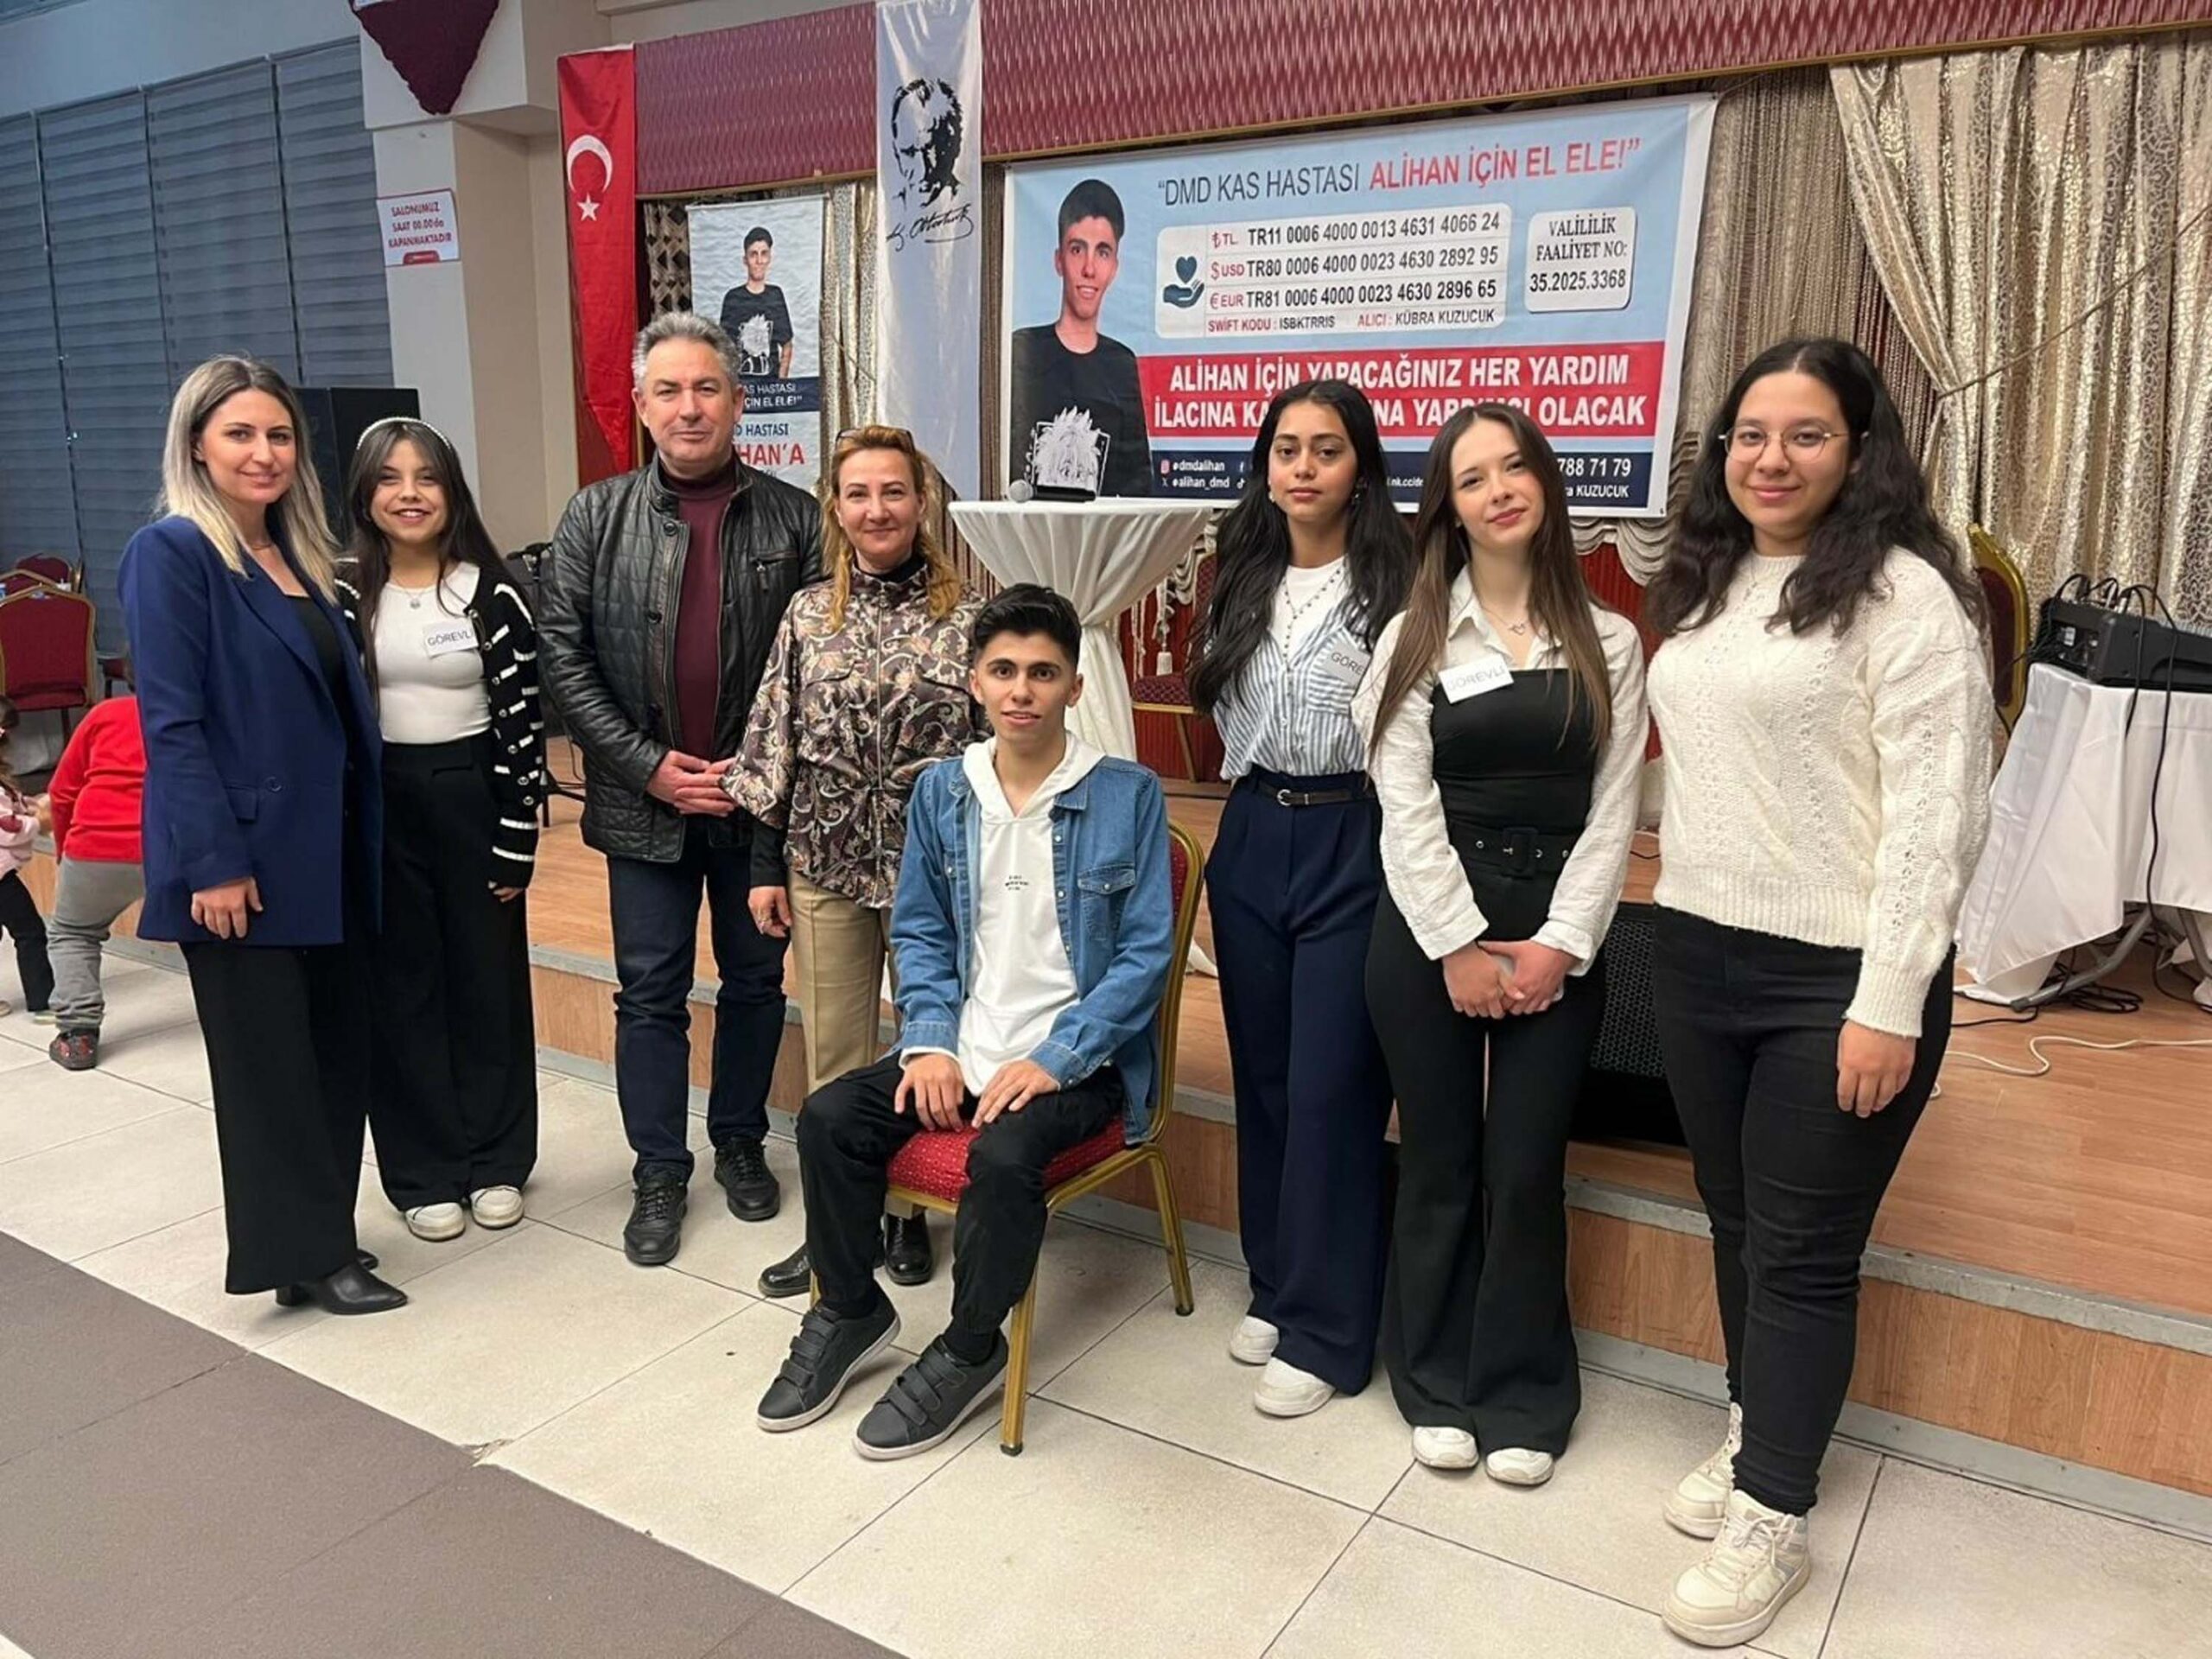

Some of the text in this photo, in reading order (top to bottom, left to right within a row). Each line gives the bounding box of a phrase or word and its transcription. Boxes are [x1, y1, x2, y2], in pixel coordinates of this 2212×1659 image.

[1217, 171, 1260, 201] KAS
[1267, 162, 1360, 198] HASTASI
[1370, 152, 1459, 191] ALİHAN
[1468, 143, 1517, 188] İÇİN
[1526, 145, 1557, 177] EL
[1248, 226, 1281, 246] TR11
[1287, 225, 1319, 244] 0006
[1323, 221, 1357, 240] 4000
[1361, 219, 1396, 239] 0013
[1401, 217, 1434, 236] 4631
[1440, 213, 1477, 233] 4066
[1481, 212, 1500, 231] 24
[1549, 213, 1616, 236] VALİLİLİK
[1247, 259, 1281, 277] TR80
[1286, 257, 1319, 276] 0006
[1323, 254, 1357, 273] 4000
[1360, 252, 1395, 270] 0023
[1399, 250, 1434, 269] 4630
[1440, 247, 1476, 267] 2892
[1480, 245, 1499, 264] 95
[1536, 238, 1627, 261] FAALİYET NO:
[1529, 269, 1626, 292] 35.2025.3368
[1246, 290, 1280, 308] TR81
[1285, 289, 1318, 307] 0006
[1321, 286, 1354, 305] 4000
[1358, 284, 1393, 303] 0023
[1397, 283, 1432, 301] 4630
[1437, 281, 1473, 300] 2896
[1478, 279, 1497, 298] 65
[1242, 318, 1271, 331] KODU
[1395, 309, 1434, 326] KÜBRA
[1438, 308, 1495, 325] KUZUCUK
[1170, 359, 1249, 391] ALİHAN
[1255, 356, 1300, 397] İÇİN
[1469, 357, 1521, 387] HER
[1529, 354, 1629, 387] YARDIM
[1154, 397, 1236, 428] İLACINA
[1538, 395, 1648, 427] OLACAK
[746, 423, 789, 436] HASTASI
[1556, 458, 1631, 477] 788 71 79
[1576, 485, 1630, 498] KUZUCUK
